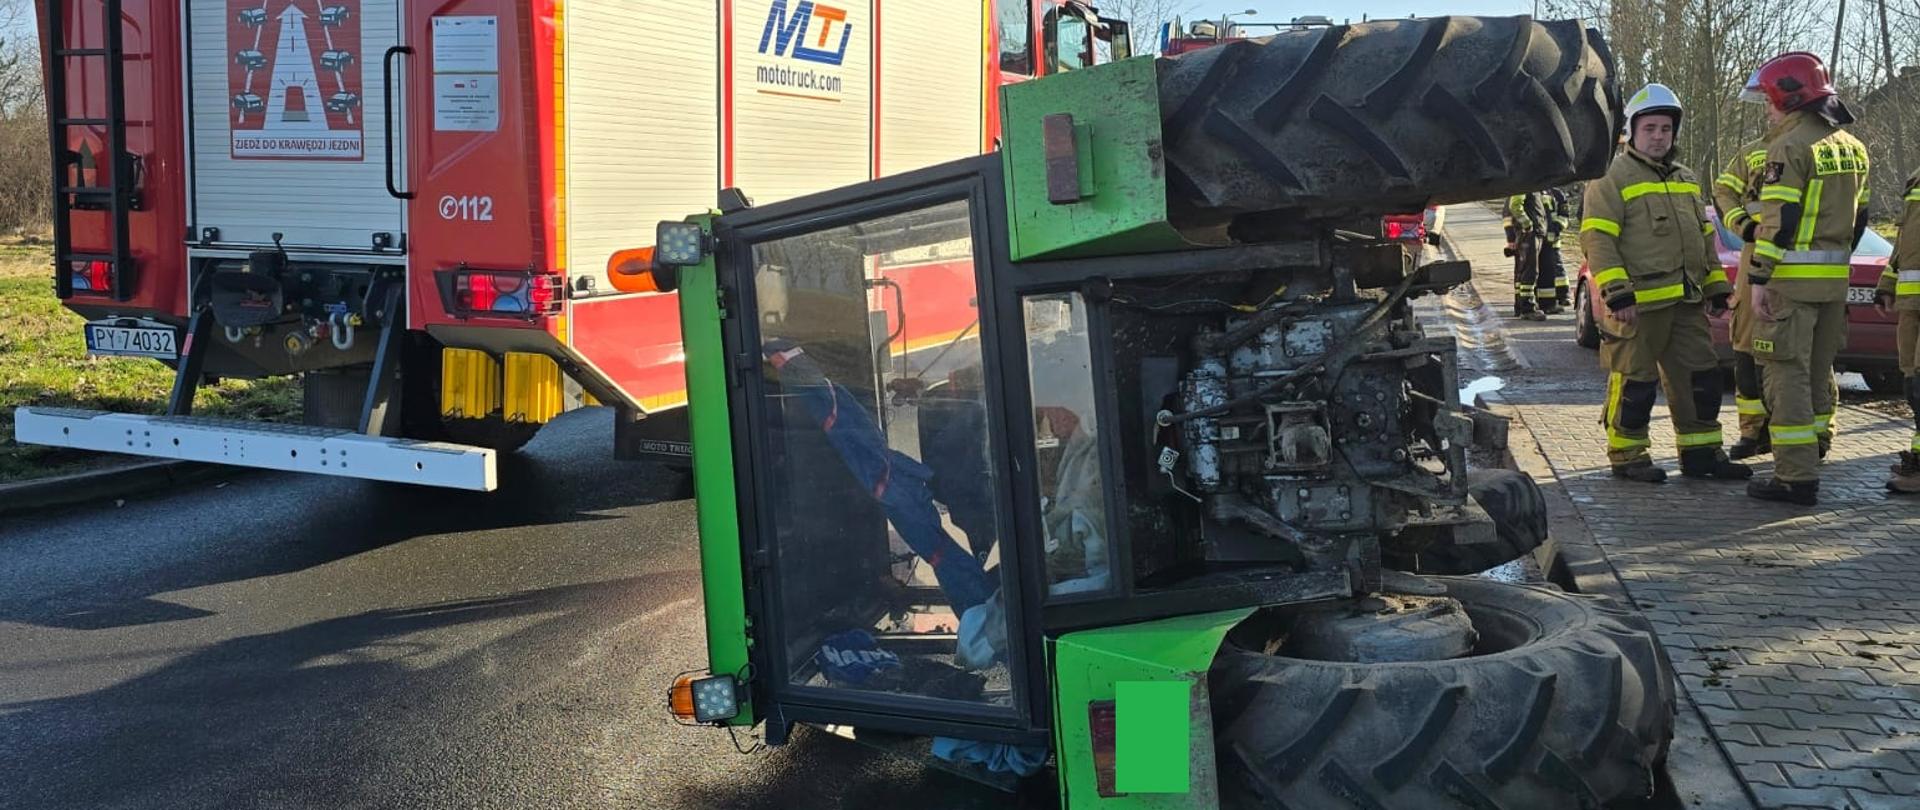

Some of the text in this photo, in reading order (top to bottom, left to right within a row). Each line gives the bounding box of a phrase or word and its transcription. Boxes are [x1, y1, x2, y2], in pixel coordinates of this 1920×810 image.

[756, 65, 842, 92] mototruck.com
[262, 139, 276, 149] DO
[278, 139, 326, 151] KRAWĘDZI
[328, 140, 360, 150] JEZDNI
[458, 195, 493, 221] 112
[1849, 288, 1874, 301] 353
[96, 328, 172, 352] PY 74032
[643, 442, 694, 454] MOTO TRUC
